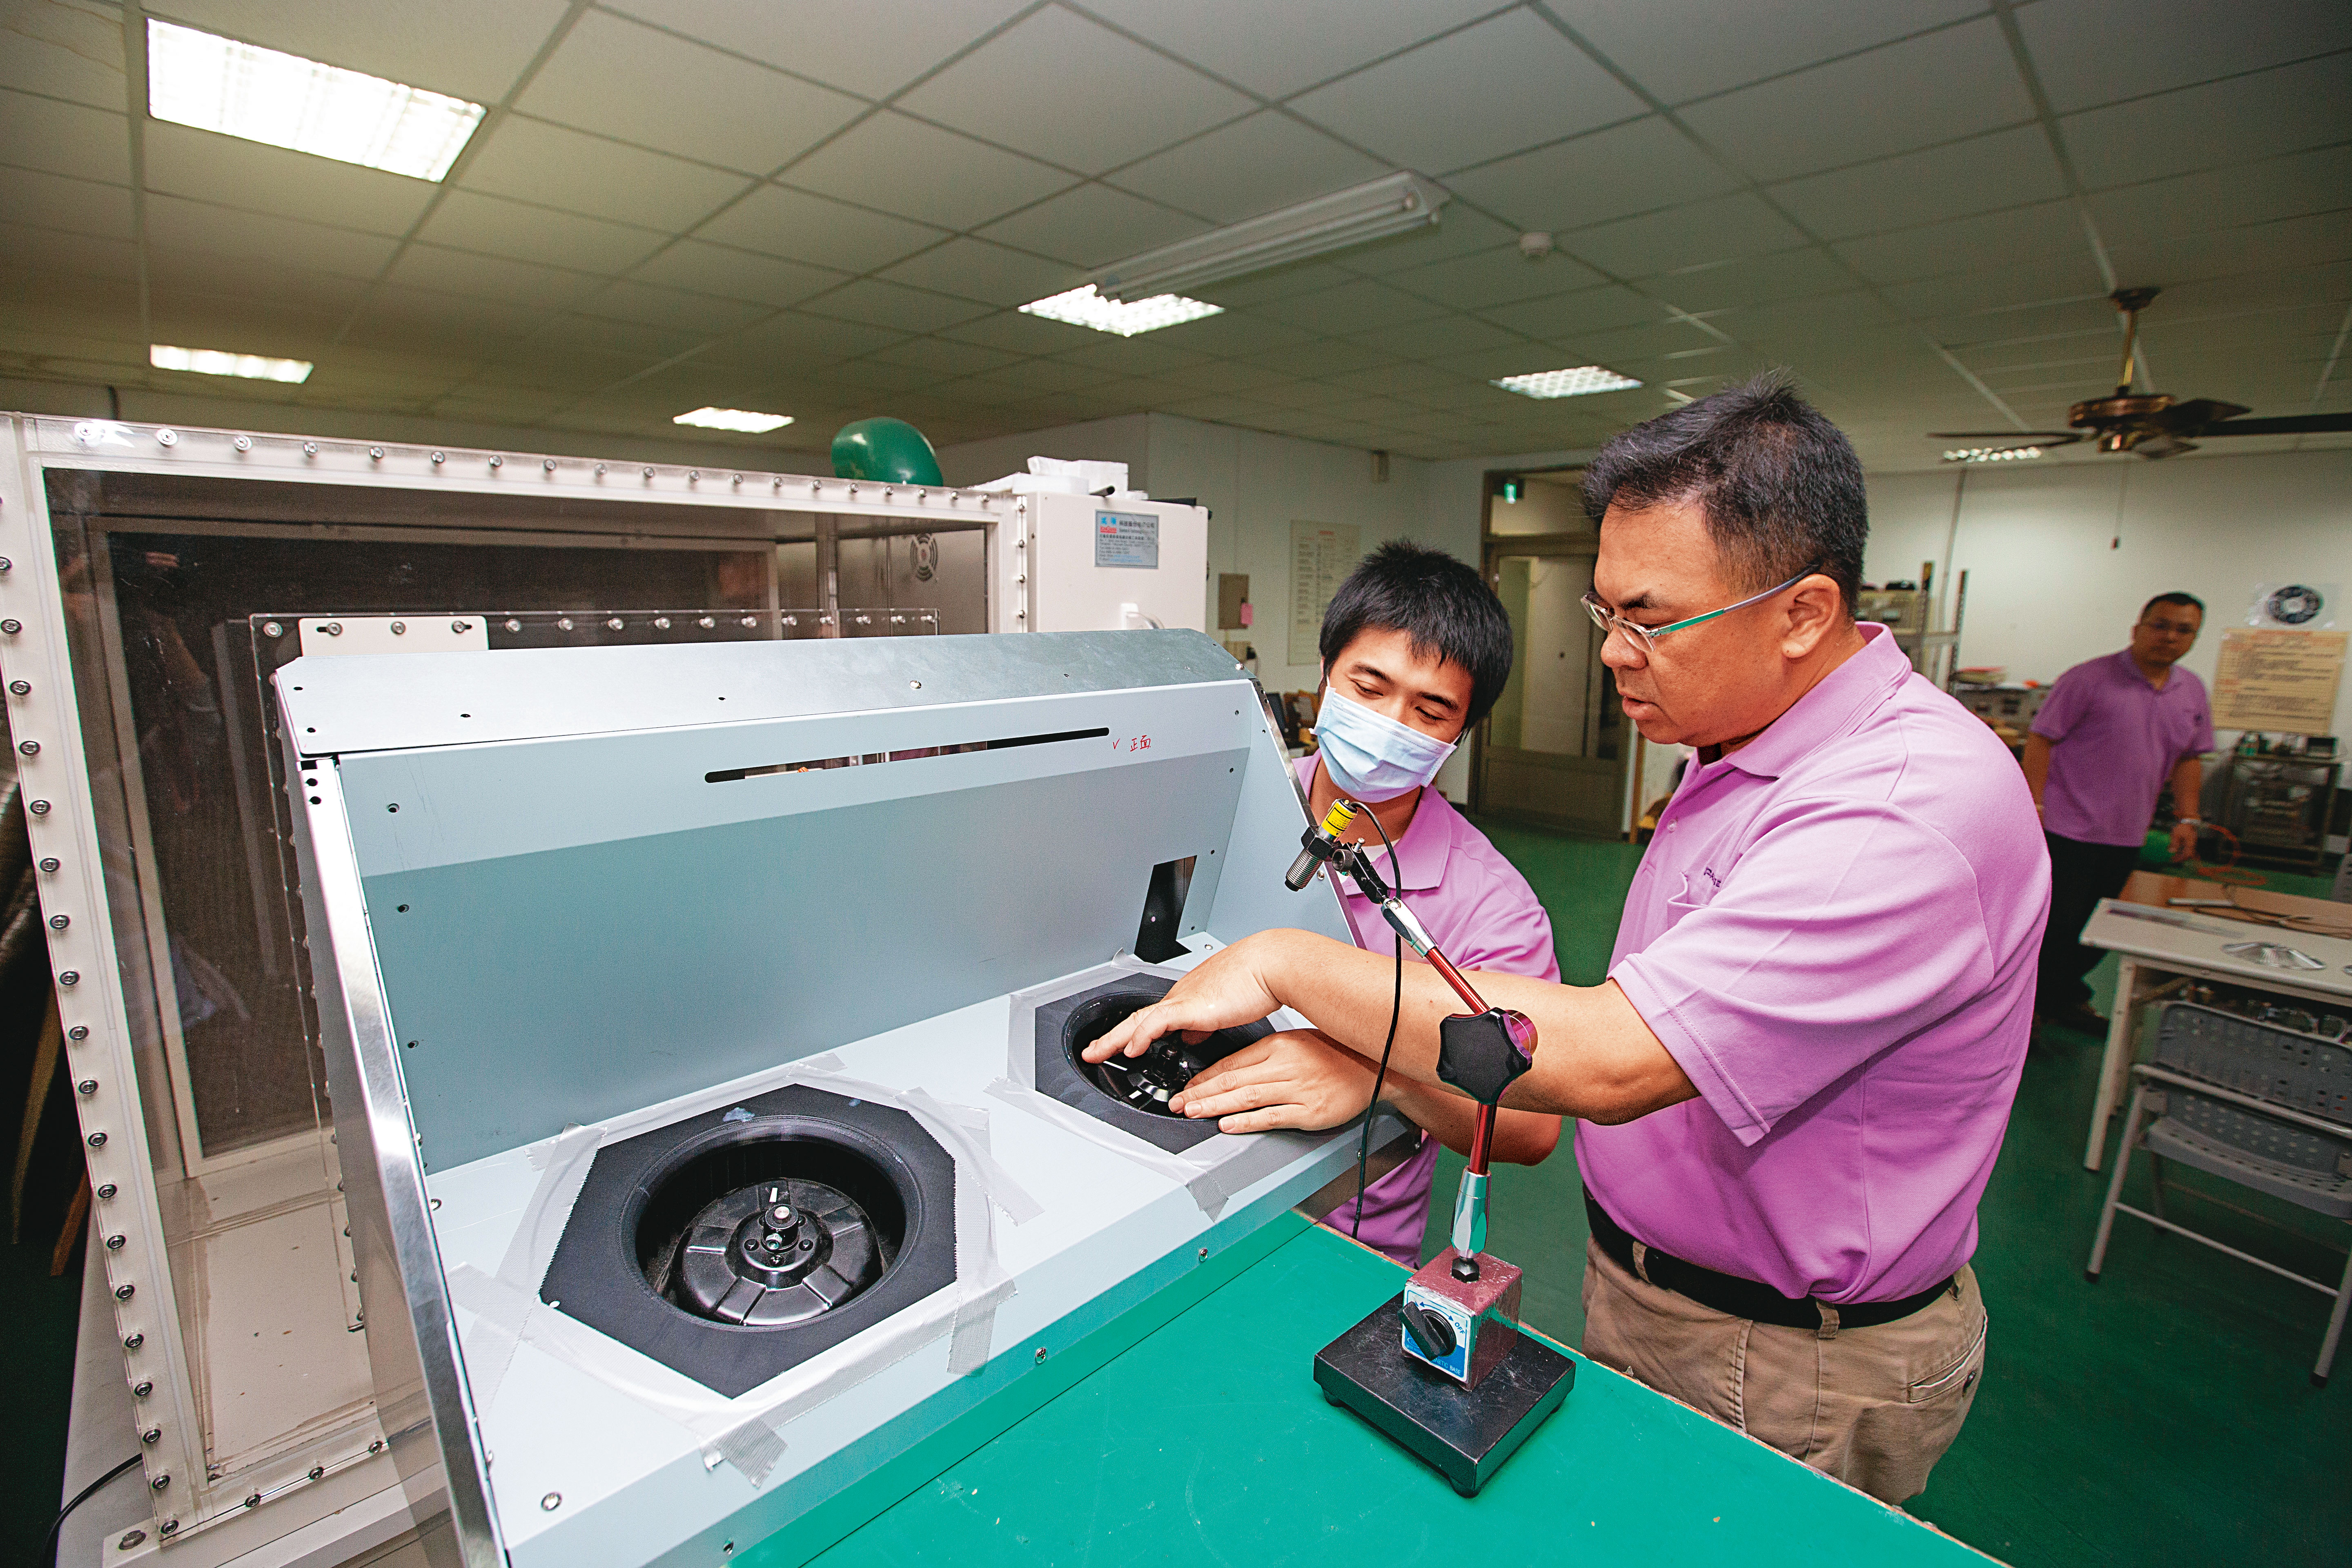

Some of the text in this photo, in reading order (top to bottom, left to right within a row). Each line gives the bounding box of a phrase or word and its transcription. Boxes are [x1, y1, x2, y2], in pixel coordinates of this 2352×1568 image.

[1130, 735, 1151, 752] 正面
[1454, 1322, 1465, 1334] OFF
[1434, 1357, 1461, 1375] GNETIC BASE
